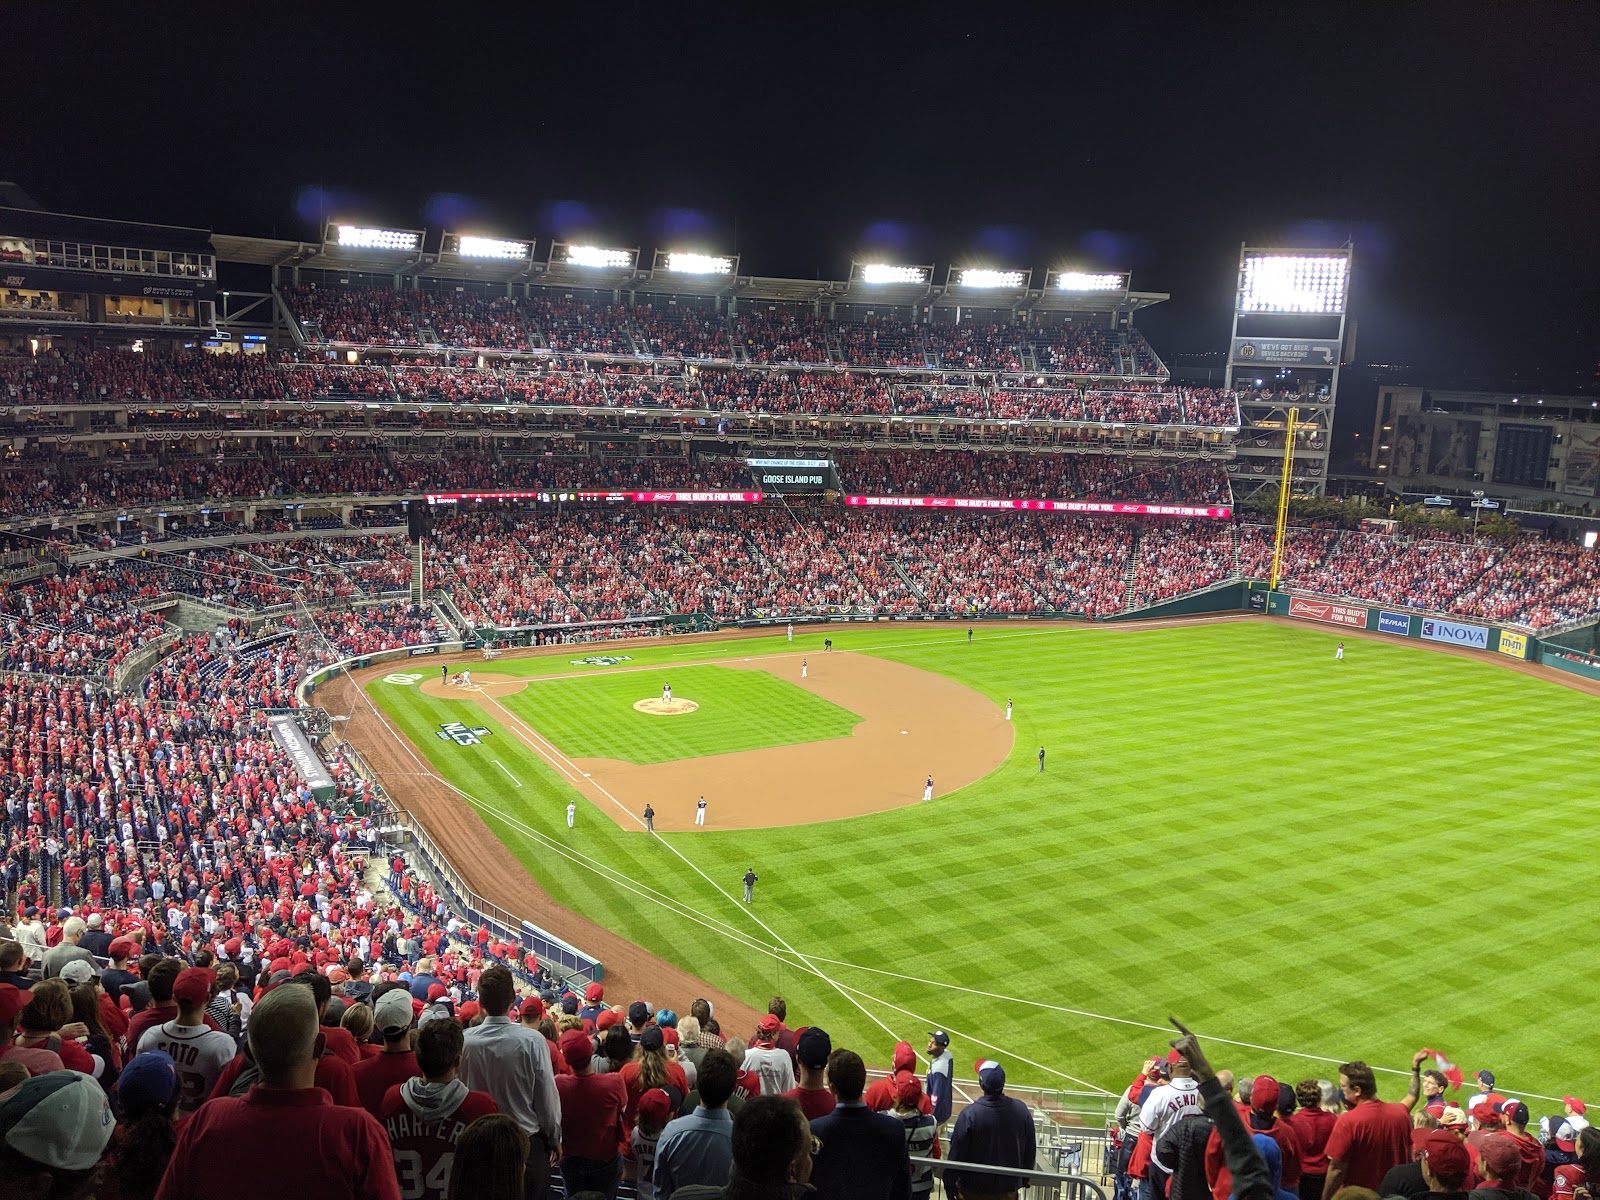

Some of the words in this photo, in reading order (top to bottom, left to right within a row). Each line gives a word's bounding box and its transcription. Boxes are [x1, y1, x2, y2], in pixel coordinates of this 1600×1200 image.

[763, 475, 784, 484] GOOSE
[785, 476, 808, 484] ISLAND
[1296, 604, 1327, 614] Budweiser
[1332, 606, 1346, 615] THIS
[1347, 608, 1366, 618] BUD'S
[1331, 614, 1343, 622] FOR
[1344, 616, 1358, 624] YOU.
[1380, 618, 1408, 628] RE/MAX
[1438, 626, 1485, 643] INOVA
[440, 722, 482, 746] NLCS
[276, 723, 304, 751] WASHINGTON
[292, 750, 319, 778] NATIONALS
